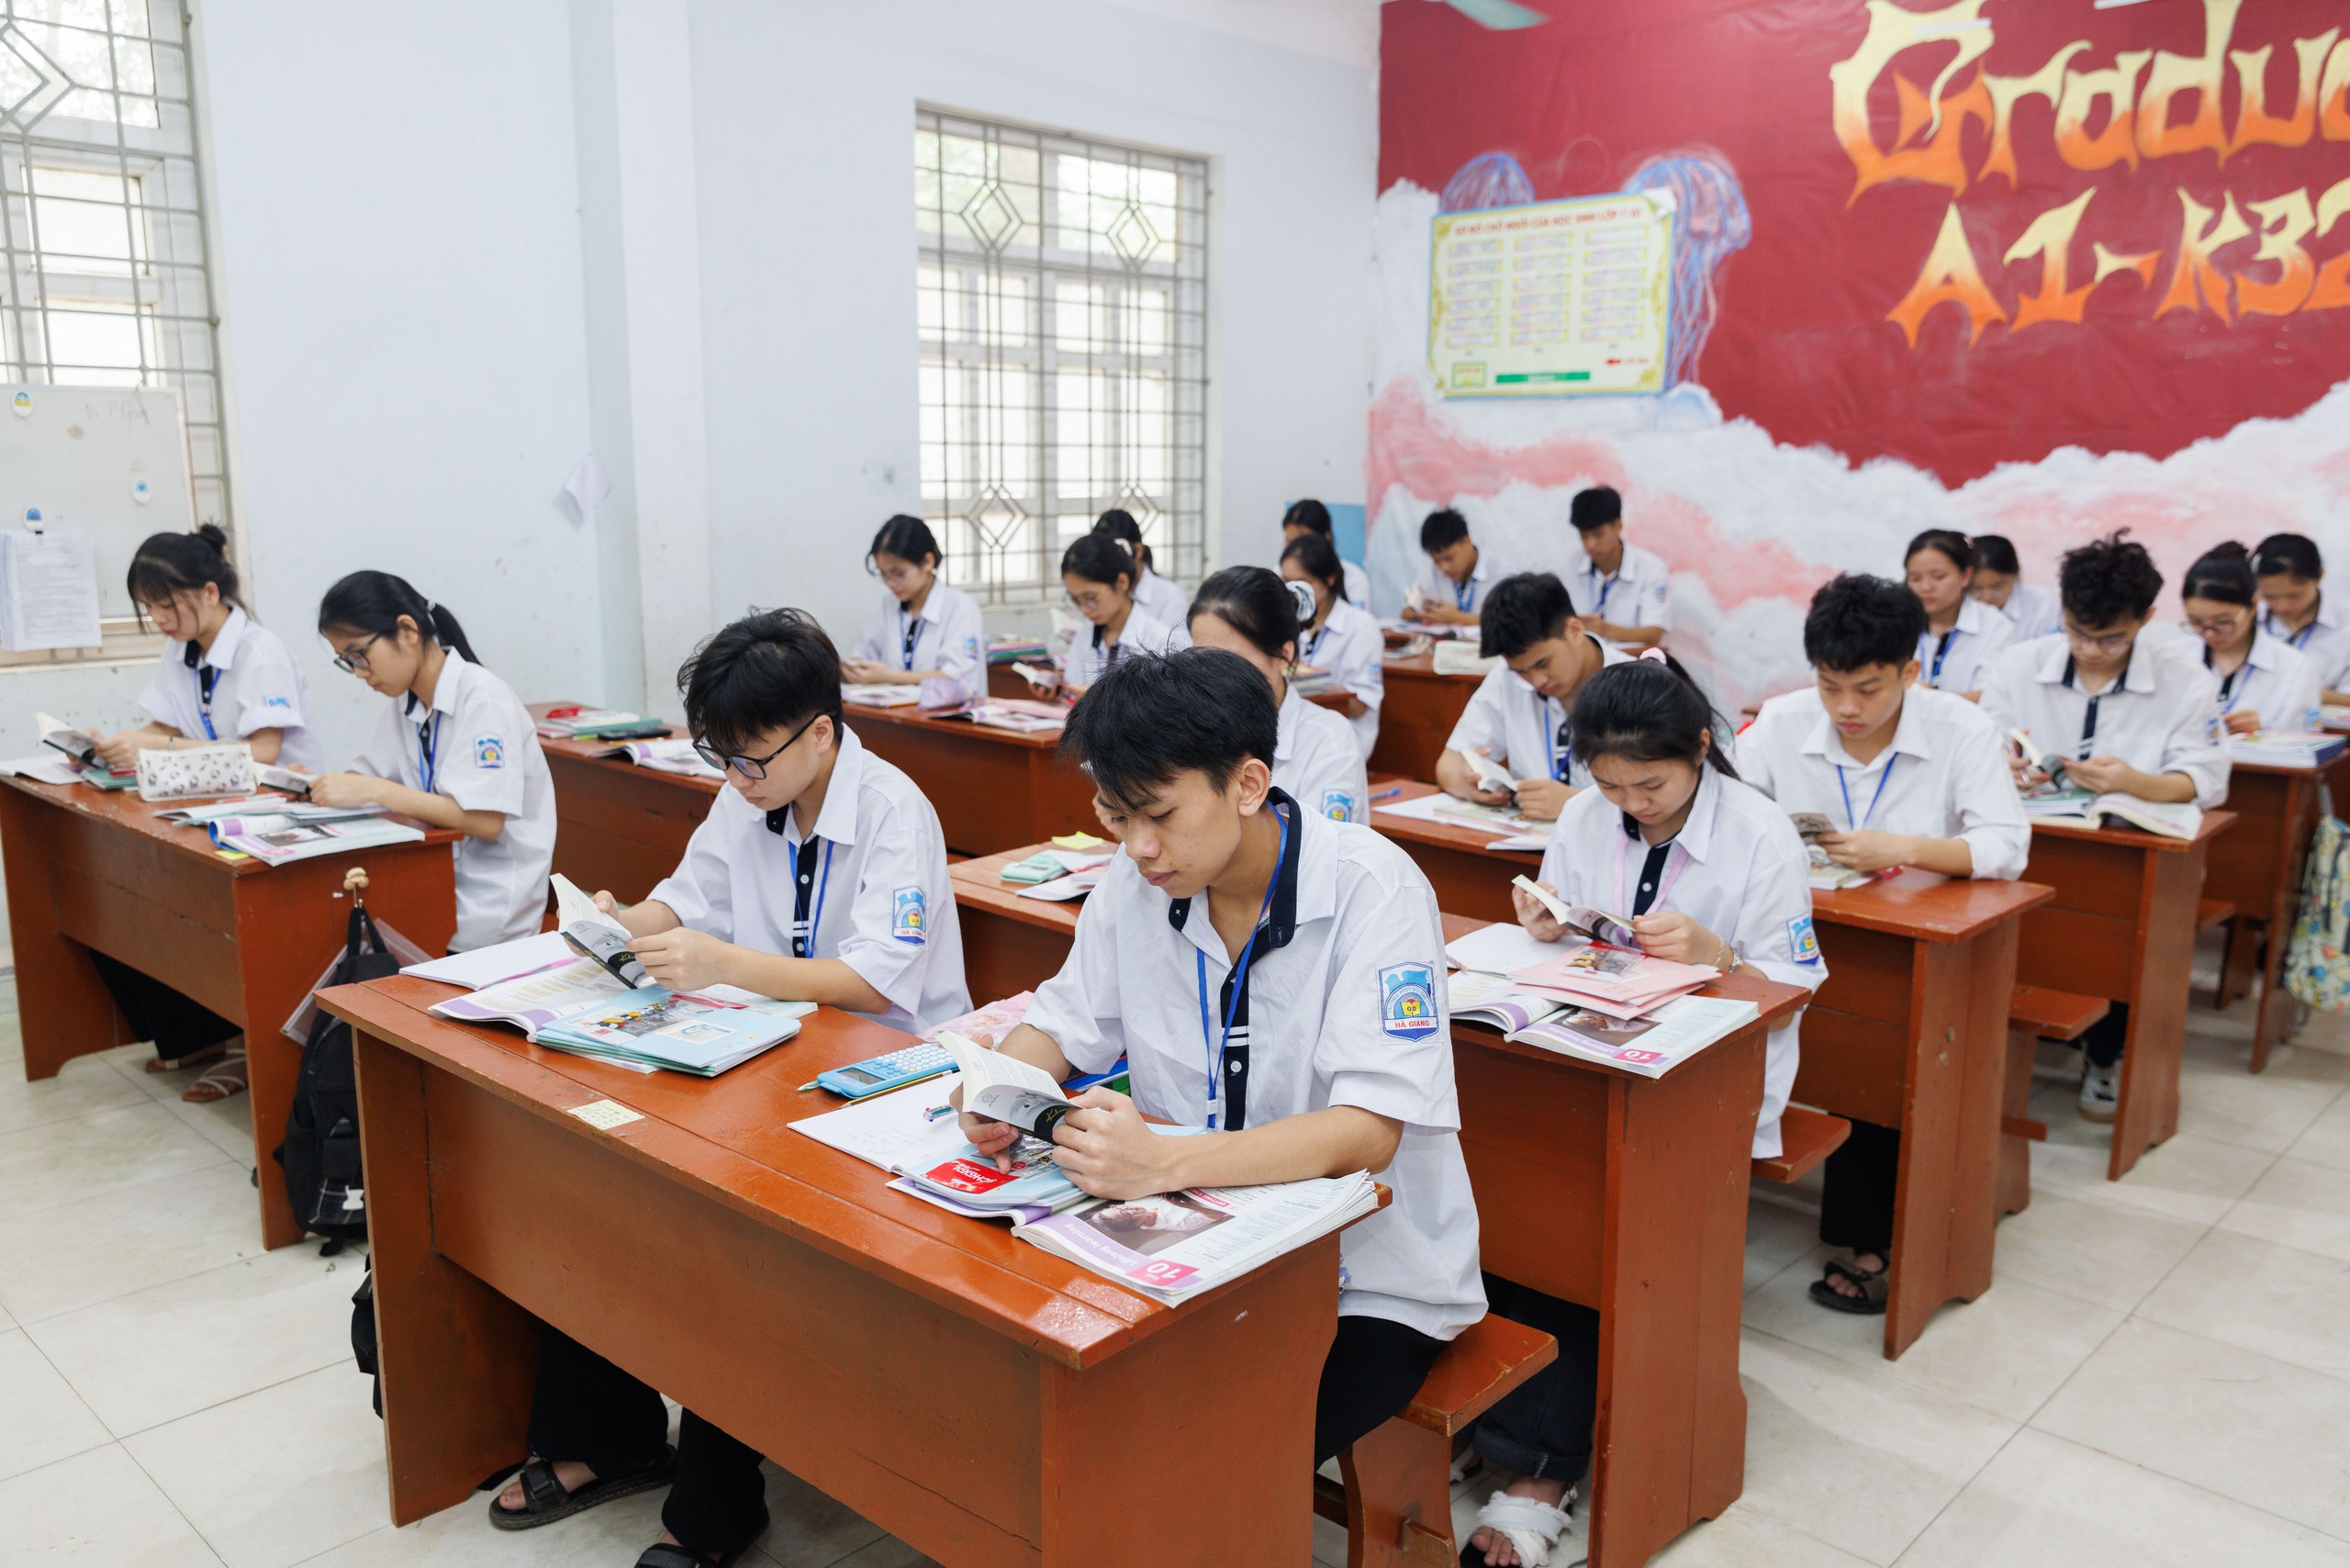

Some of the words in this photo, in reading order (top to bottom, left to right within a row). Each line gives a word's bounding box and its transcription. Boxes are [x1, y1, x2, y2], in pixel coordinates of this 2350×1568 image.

[1395, 1019, 1406, 1028] HÀ
[1408, 1020, 1430, 1028] GIANG
[1624, 1050, 1651, 1059] 10
[1063, 1222, 1101, 1249] learning
[1099, 1244, 1138, 1266] Lifelong
[1146, 1262, 1182, 1279] 10
